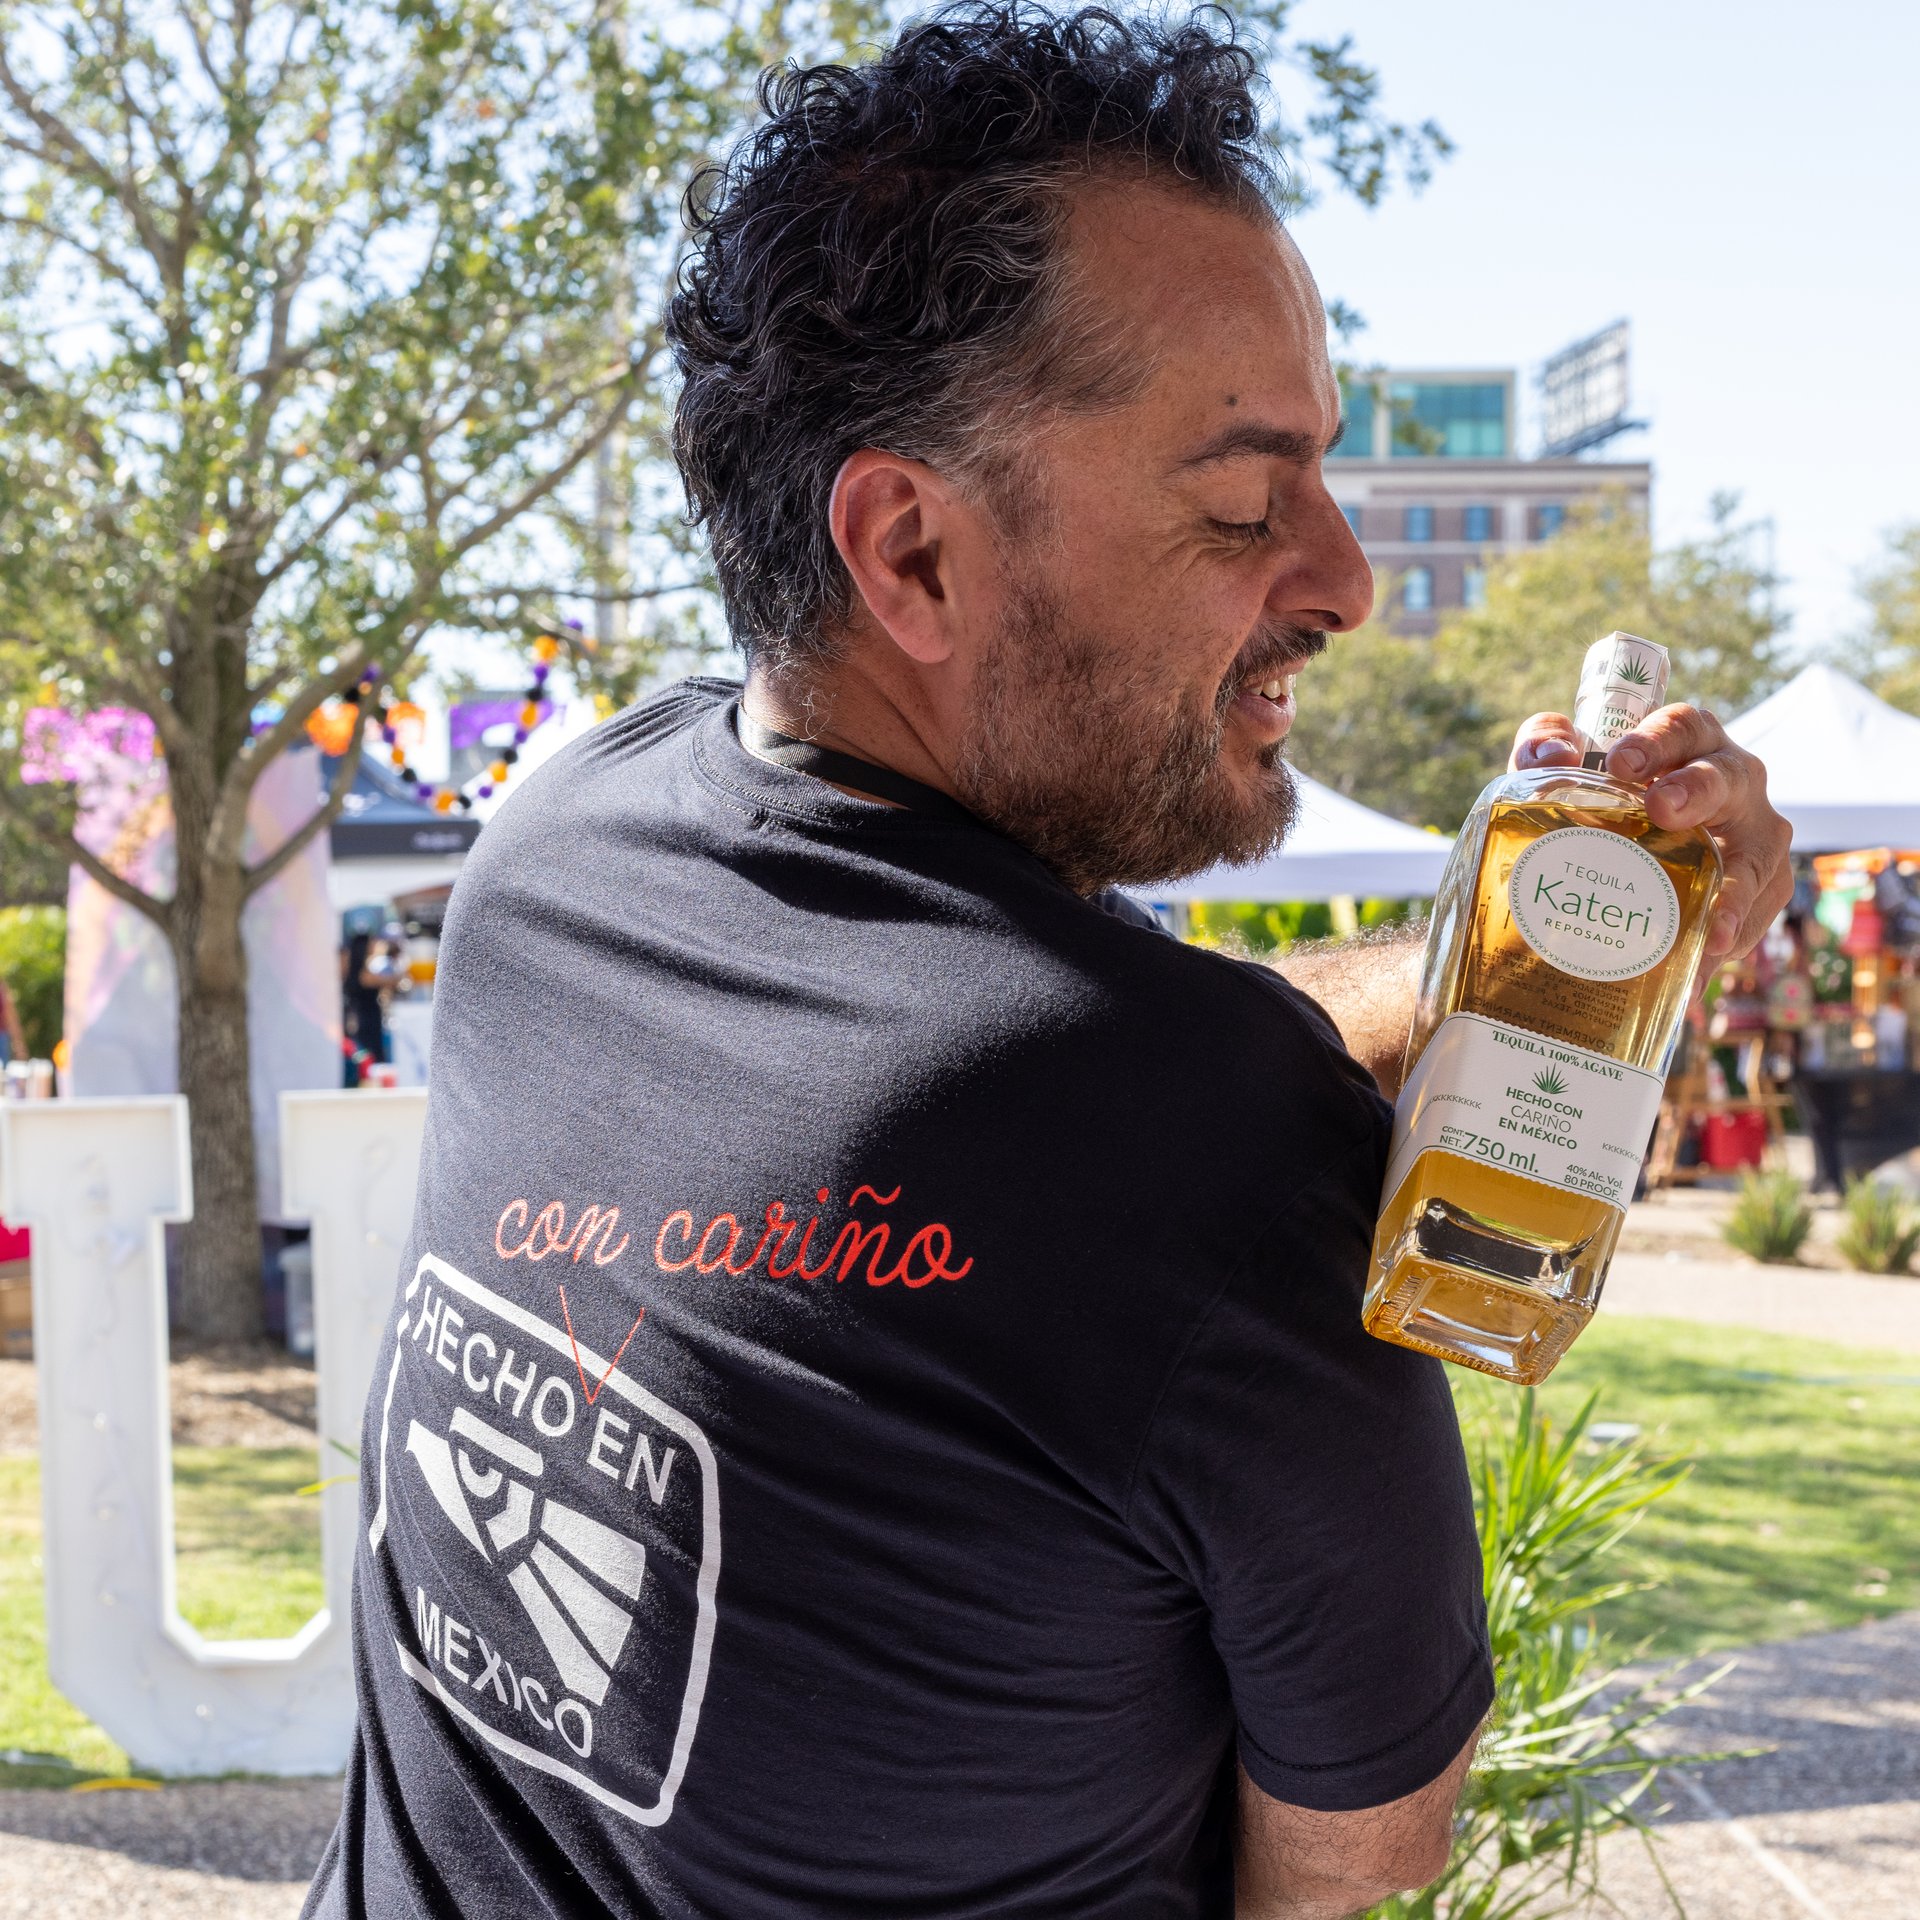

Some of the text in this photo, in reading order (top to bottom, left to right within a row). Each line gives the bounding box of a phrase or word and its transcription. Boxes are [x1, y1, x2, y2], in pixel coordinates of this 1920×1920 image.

[1598, 729, 1624, 740] AGA
[1563, 861, 1636, 894] TEQUILA
[1533, 873, 1654, 937] Kateri
[1544, 917, 1626, 949] REPOSADO
[1492, 1030, 1624, 1081] TEQUILA 100% AGAVE
[1505, 1086, 1583, 1119] HECHO CON
[1510, 1105, 1572, 1133] CARIÑO
[1441, 1125, 1465, 1138] CONT.
[1498, 1117, 1577, 1150] EN MÉXICO
[1439, 1131, 1540, 1173] NET. 750 ml.
[1563, 1174, 1620, 1201] 80 PROOF.
[1566, 1164, 1624, 1190] 40% Alc. Vol.
[494, 1183, 975, 1290] con cariño
[411, 1285, 677, 1506] HECHO EN
[415, 1584, 594, 1759] MEXICO
